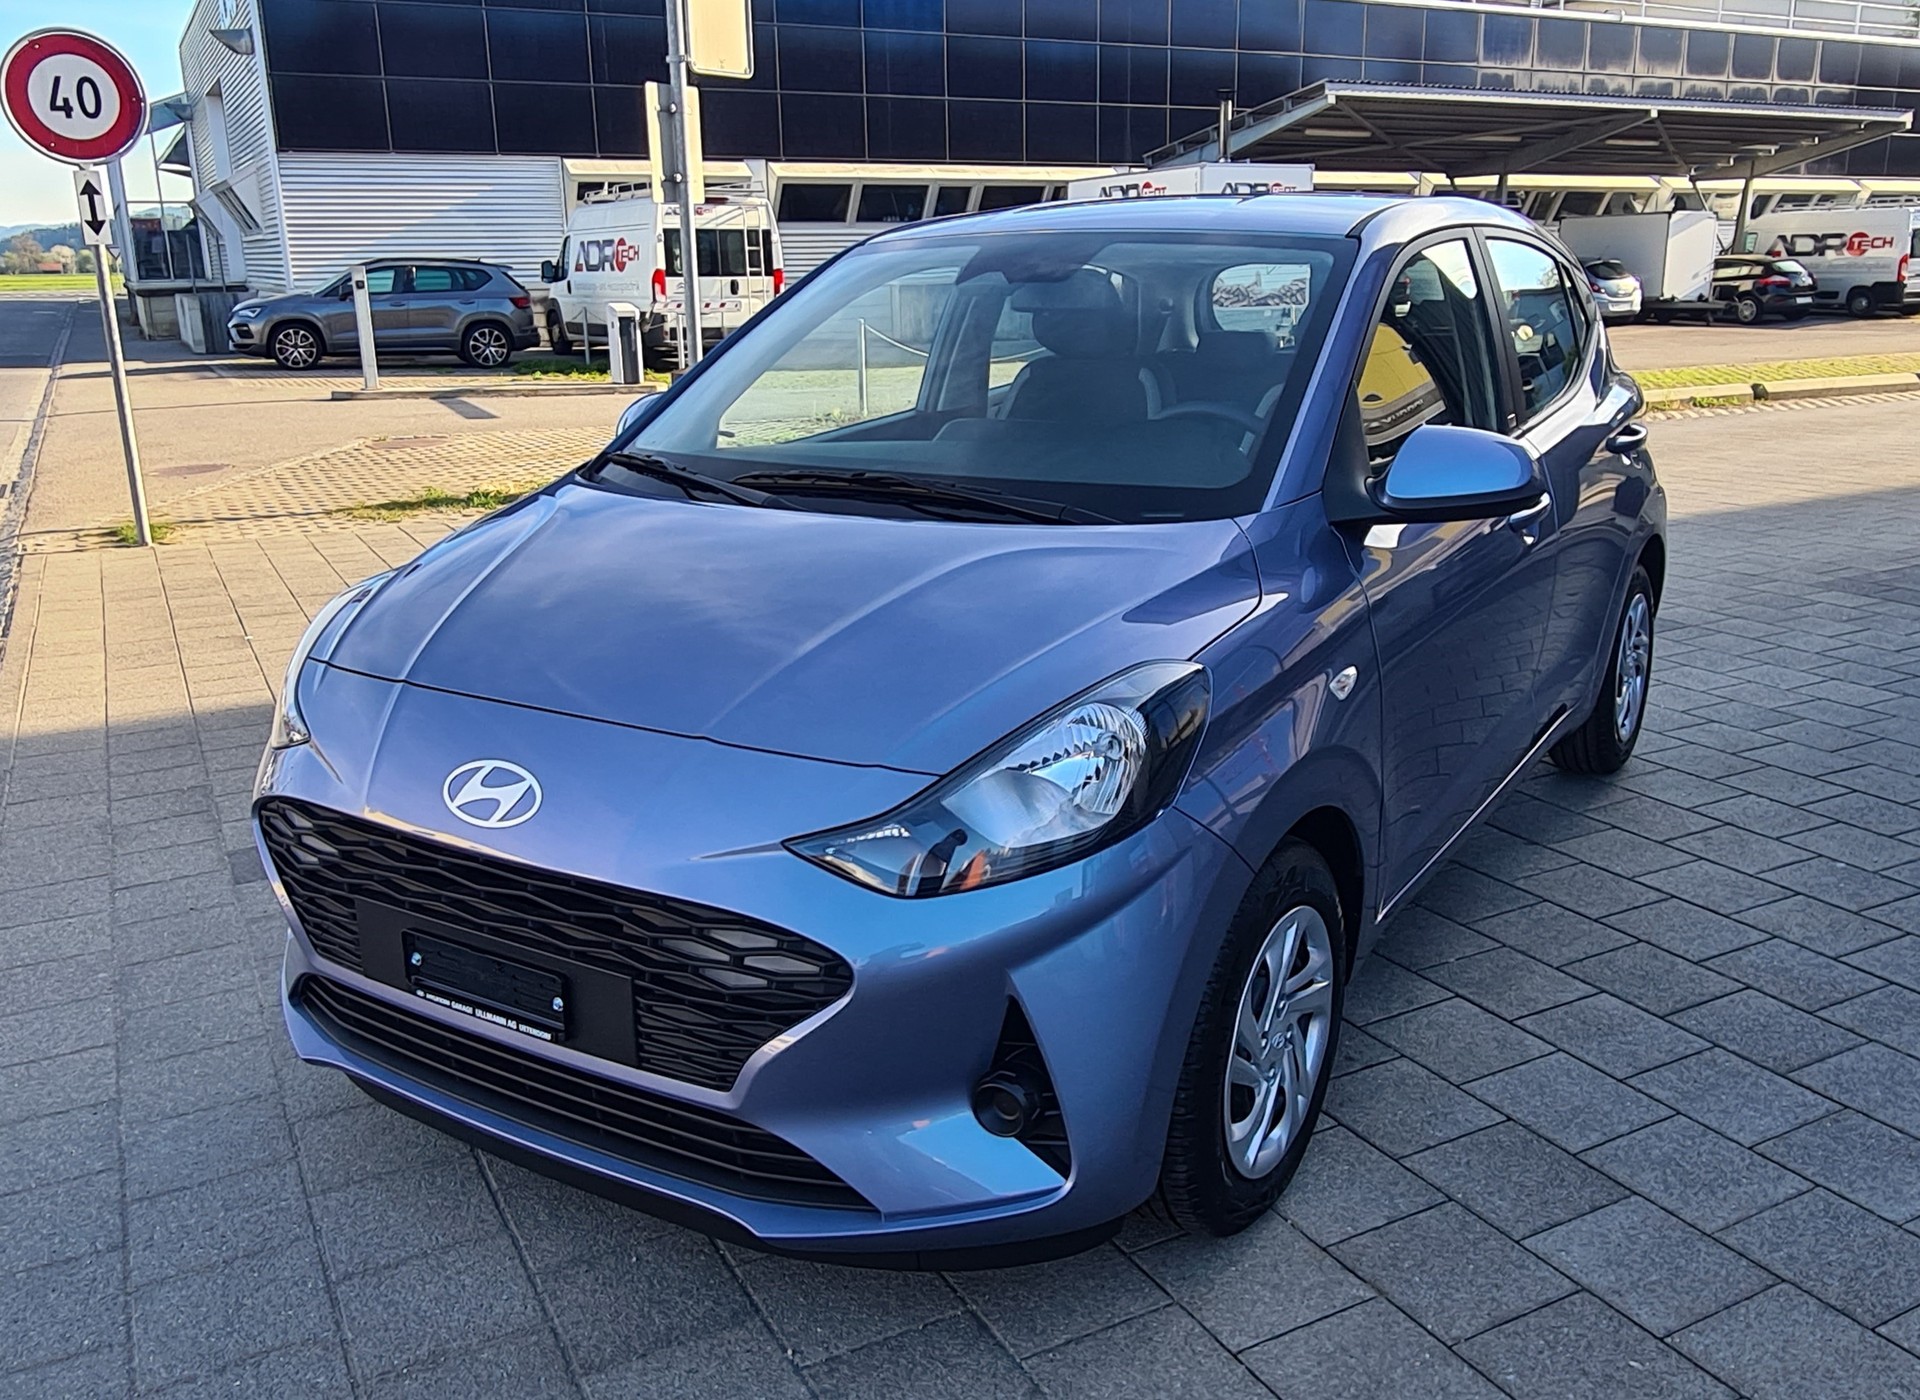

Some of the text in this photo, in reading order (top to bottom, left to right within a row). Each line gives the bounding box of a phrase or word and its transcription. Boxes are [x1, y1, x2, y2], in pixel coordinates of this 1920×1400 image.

[50, 76, 102, 119] 40
[575, 239, 615, 272] ADR
[1765, 233, 1894, 257] ADR TECH
